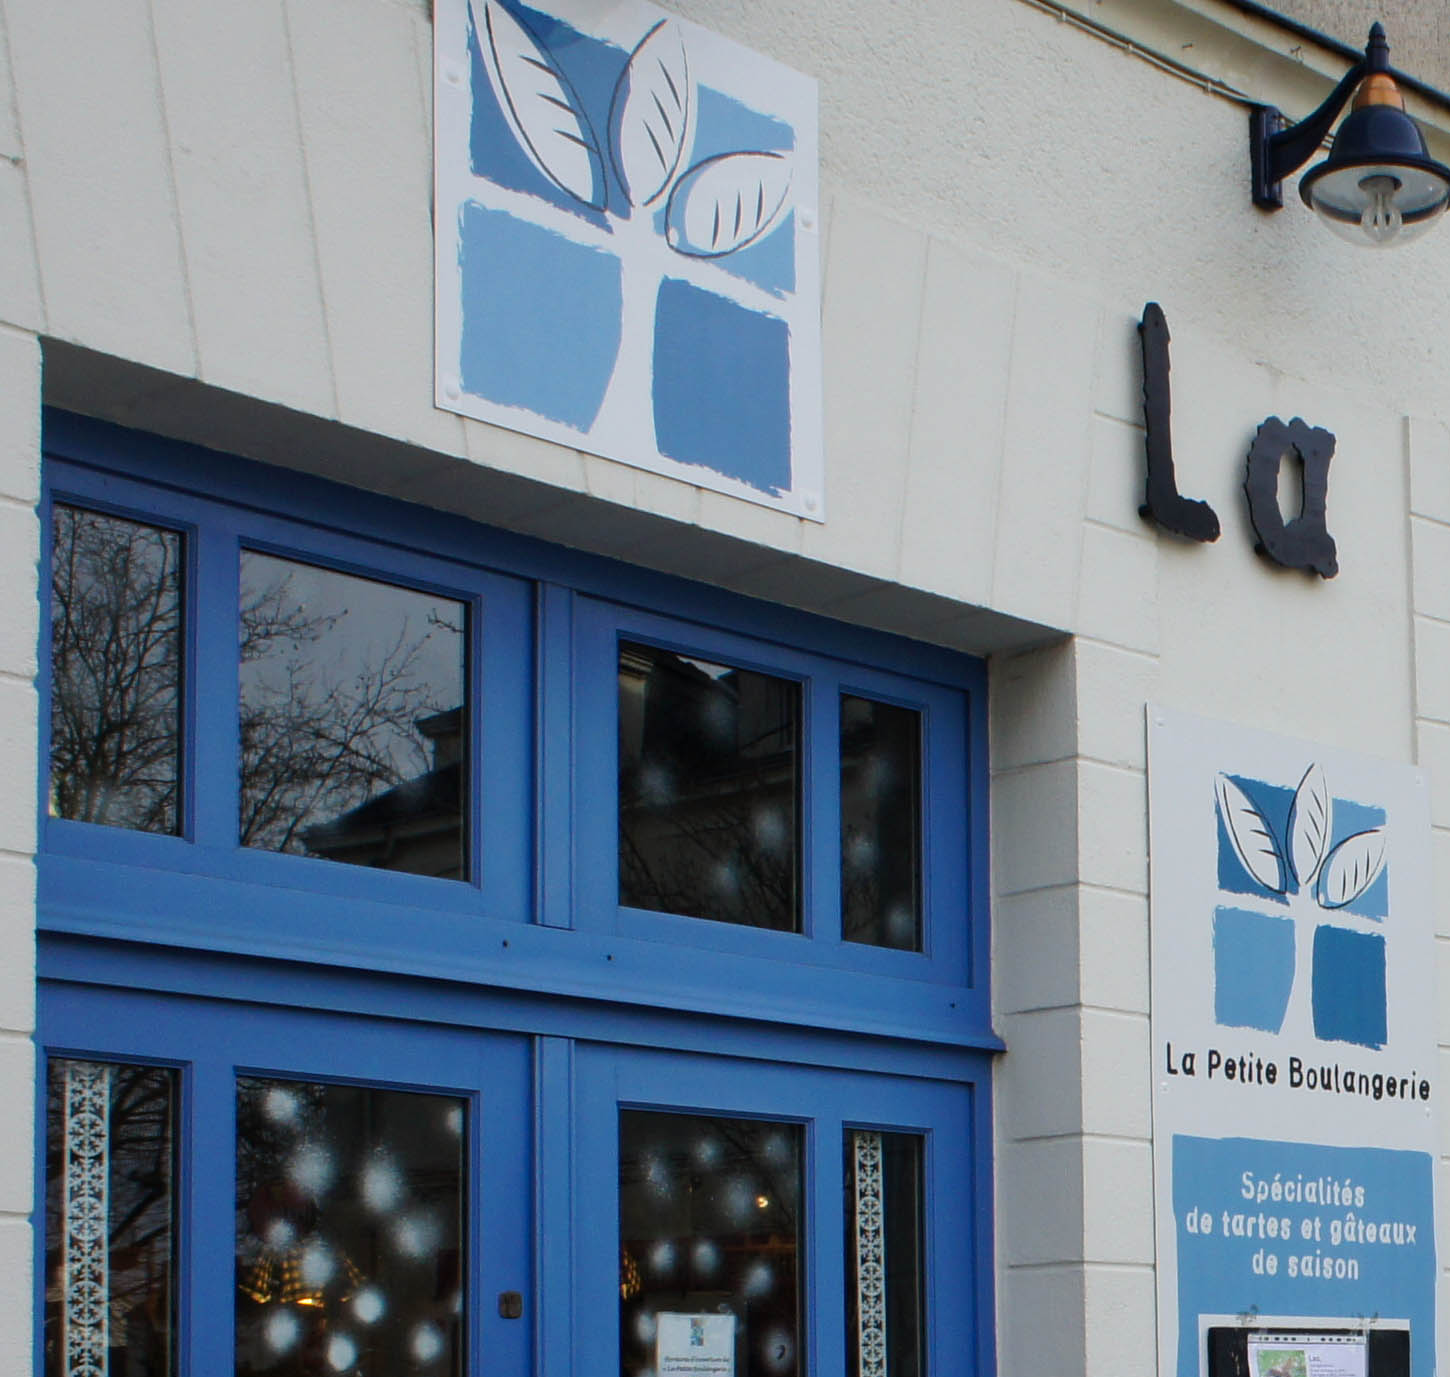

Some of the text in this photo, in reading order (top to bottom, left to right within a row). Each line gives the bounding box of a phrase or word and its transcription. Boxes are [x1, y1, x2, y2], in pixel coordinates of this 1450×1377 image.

[1139, 301, 1338, 579] La
[1166, 1042, 1431, 1100] La Petite Boulangerie
[1241, 1171, 1365, 1208] Spécialités
[1186, 1206, 1416, 1245] de tartes et gâteaux
[1252, 1248, 1359, 1280] de saison
